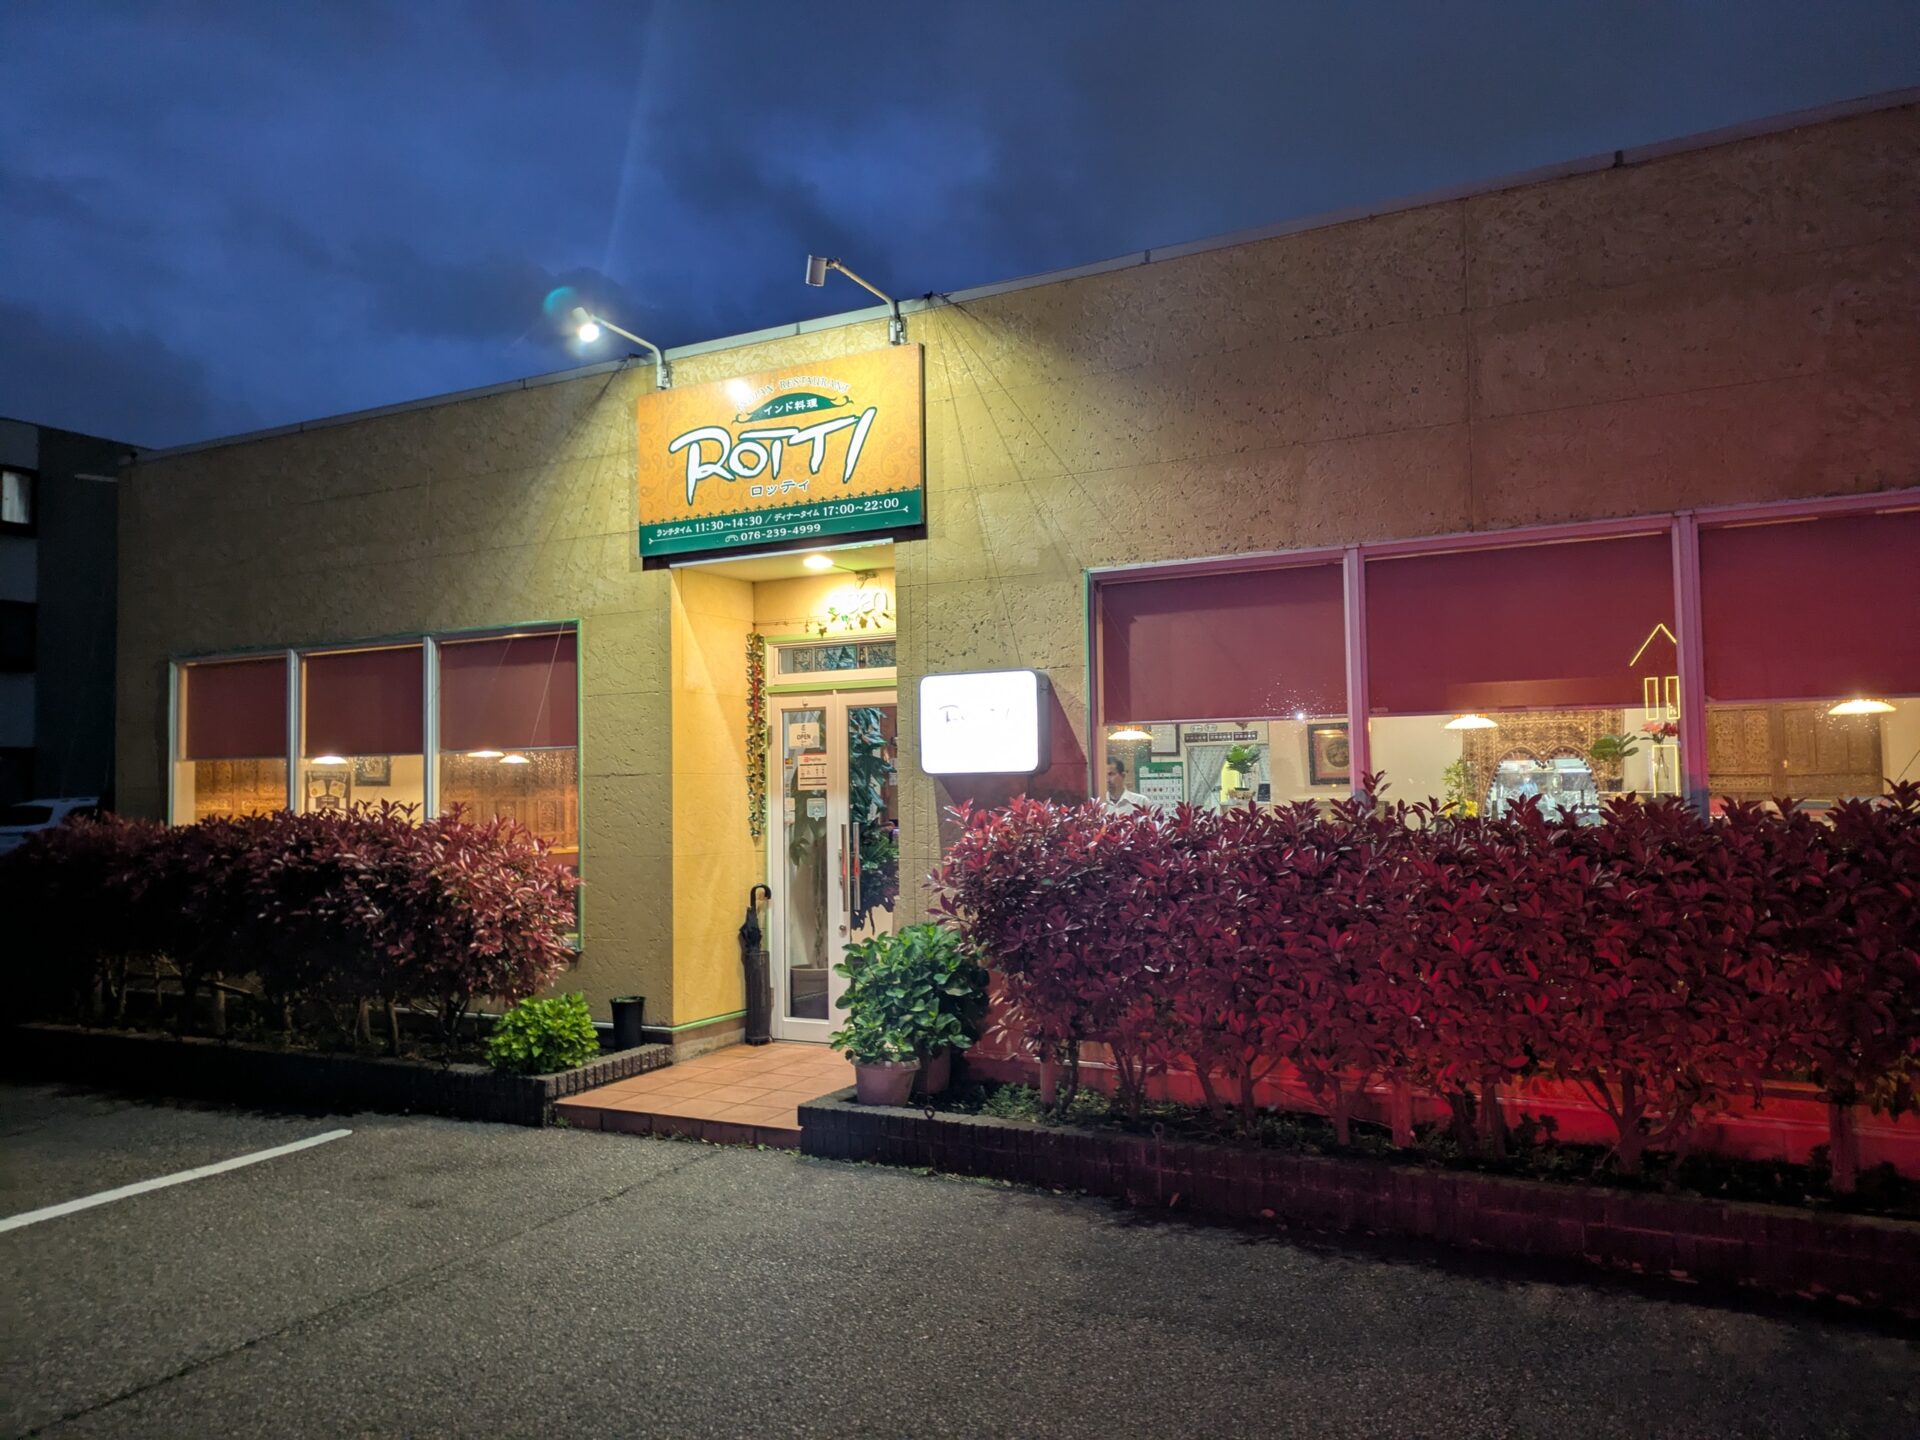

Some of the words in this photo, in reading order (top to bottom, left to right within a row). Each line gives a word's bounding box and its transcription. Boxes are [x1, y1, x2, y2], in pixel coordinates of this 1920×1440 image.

[764, 398, 818, 416] インド料理
[668, 407, 877, 506] ROTTI
[656, 525, 693, 538] ランチタイム
[774, 511, 820, 523] ディナータイム
[740, 524, 822, 541] 076-239-4999
